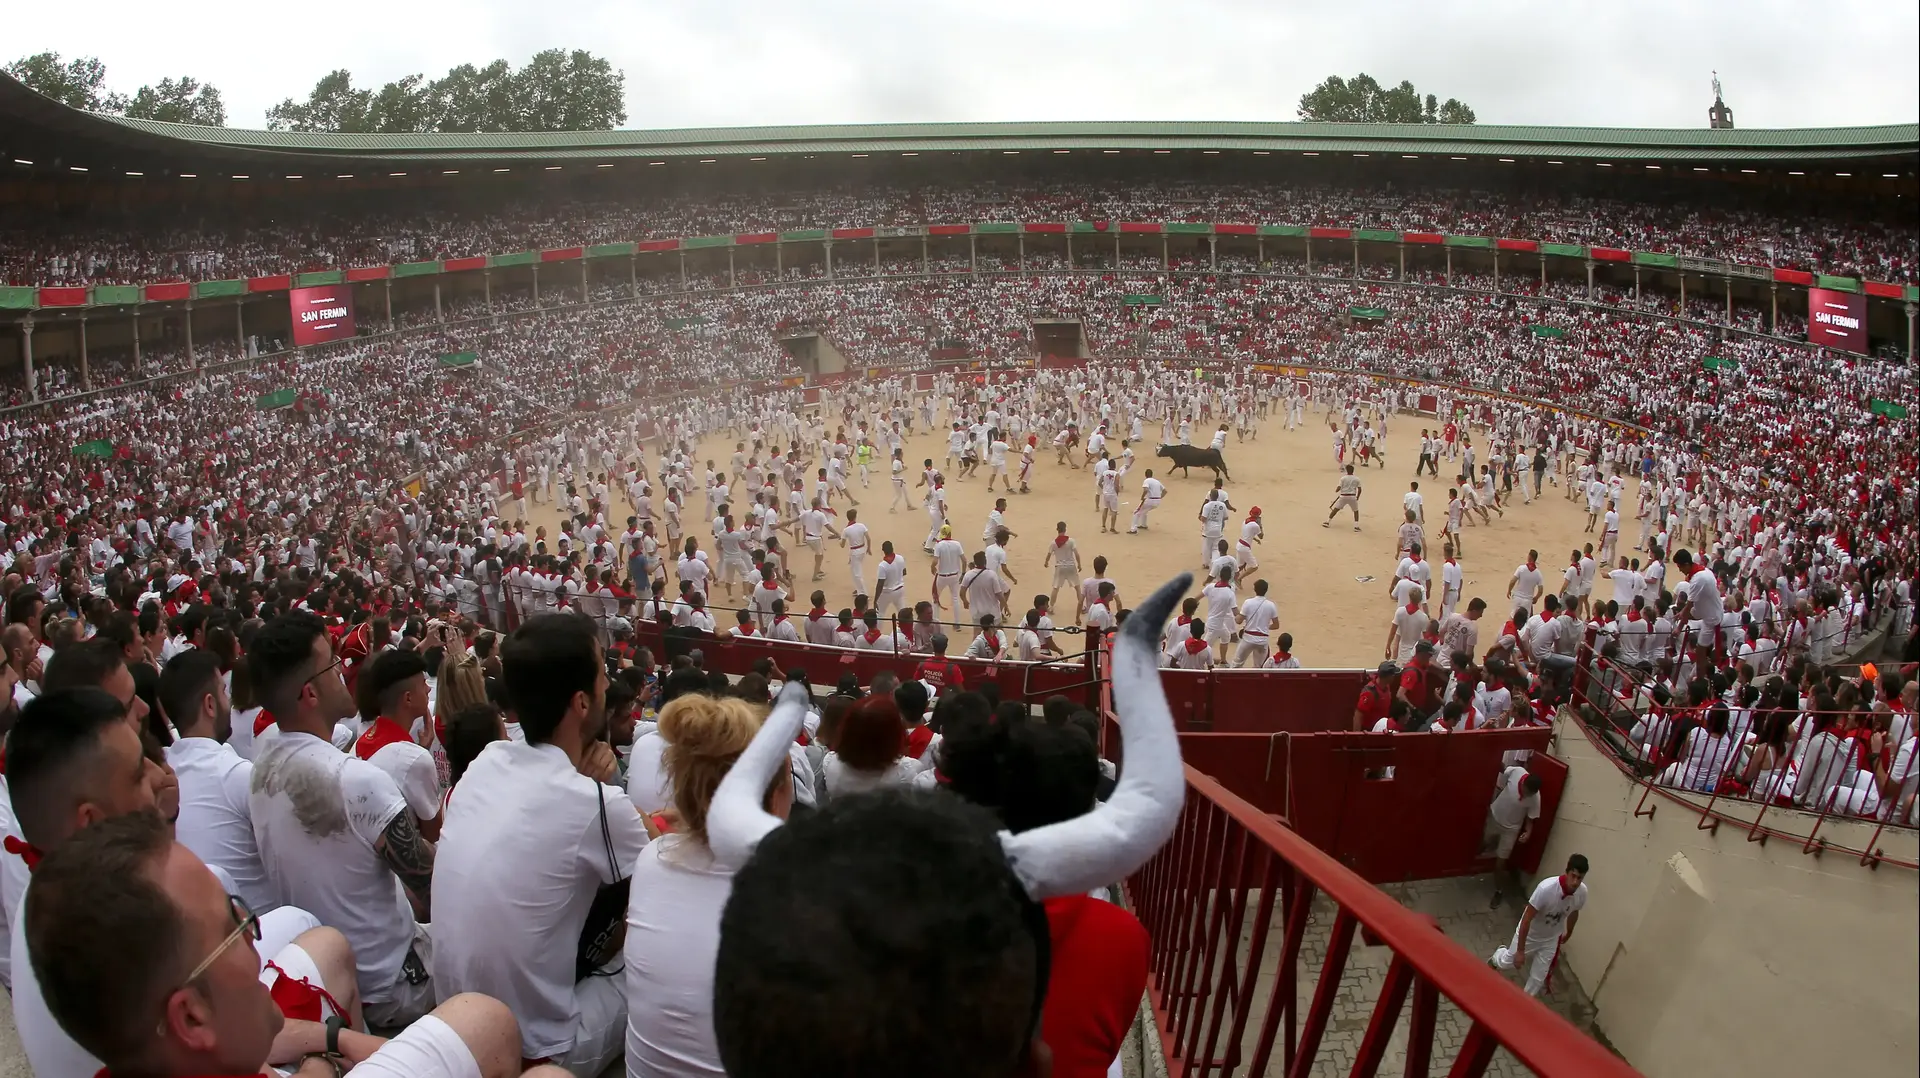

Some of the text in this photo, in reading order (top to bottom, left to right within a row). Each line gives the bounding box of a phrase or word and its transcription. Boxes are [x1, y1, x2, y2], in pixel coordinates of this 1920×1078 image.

[301, 306, 347, 323] SAN FERMIN
[1815, 311, 1859, 330] SAN FERMIN
